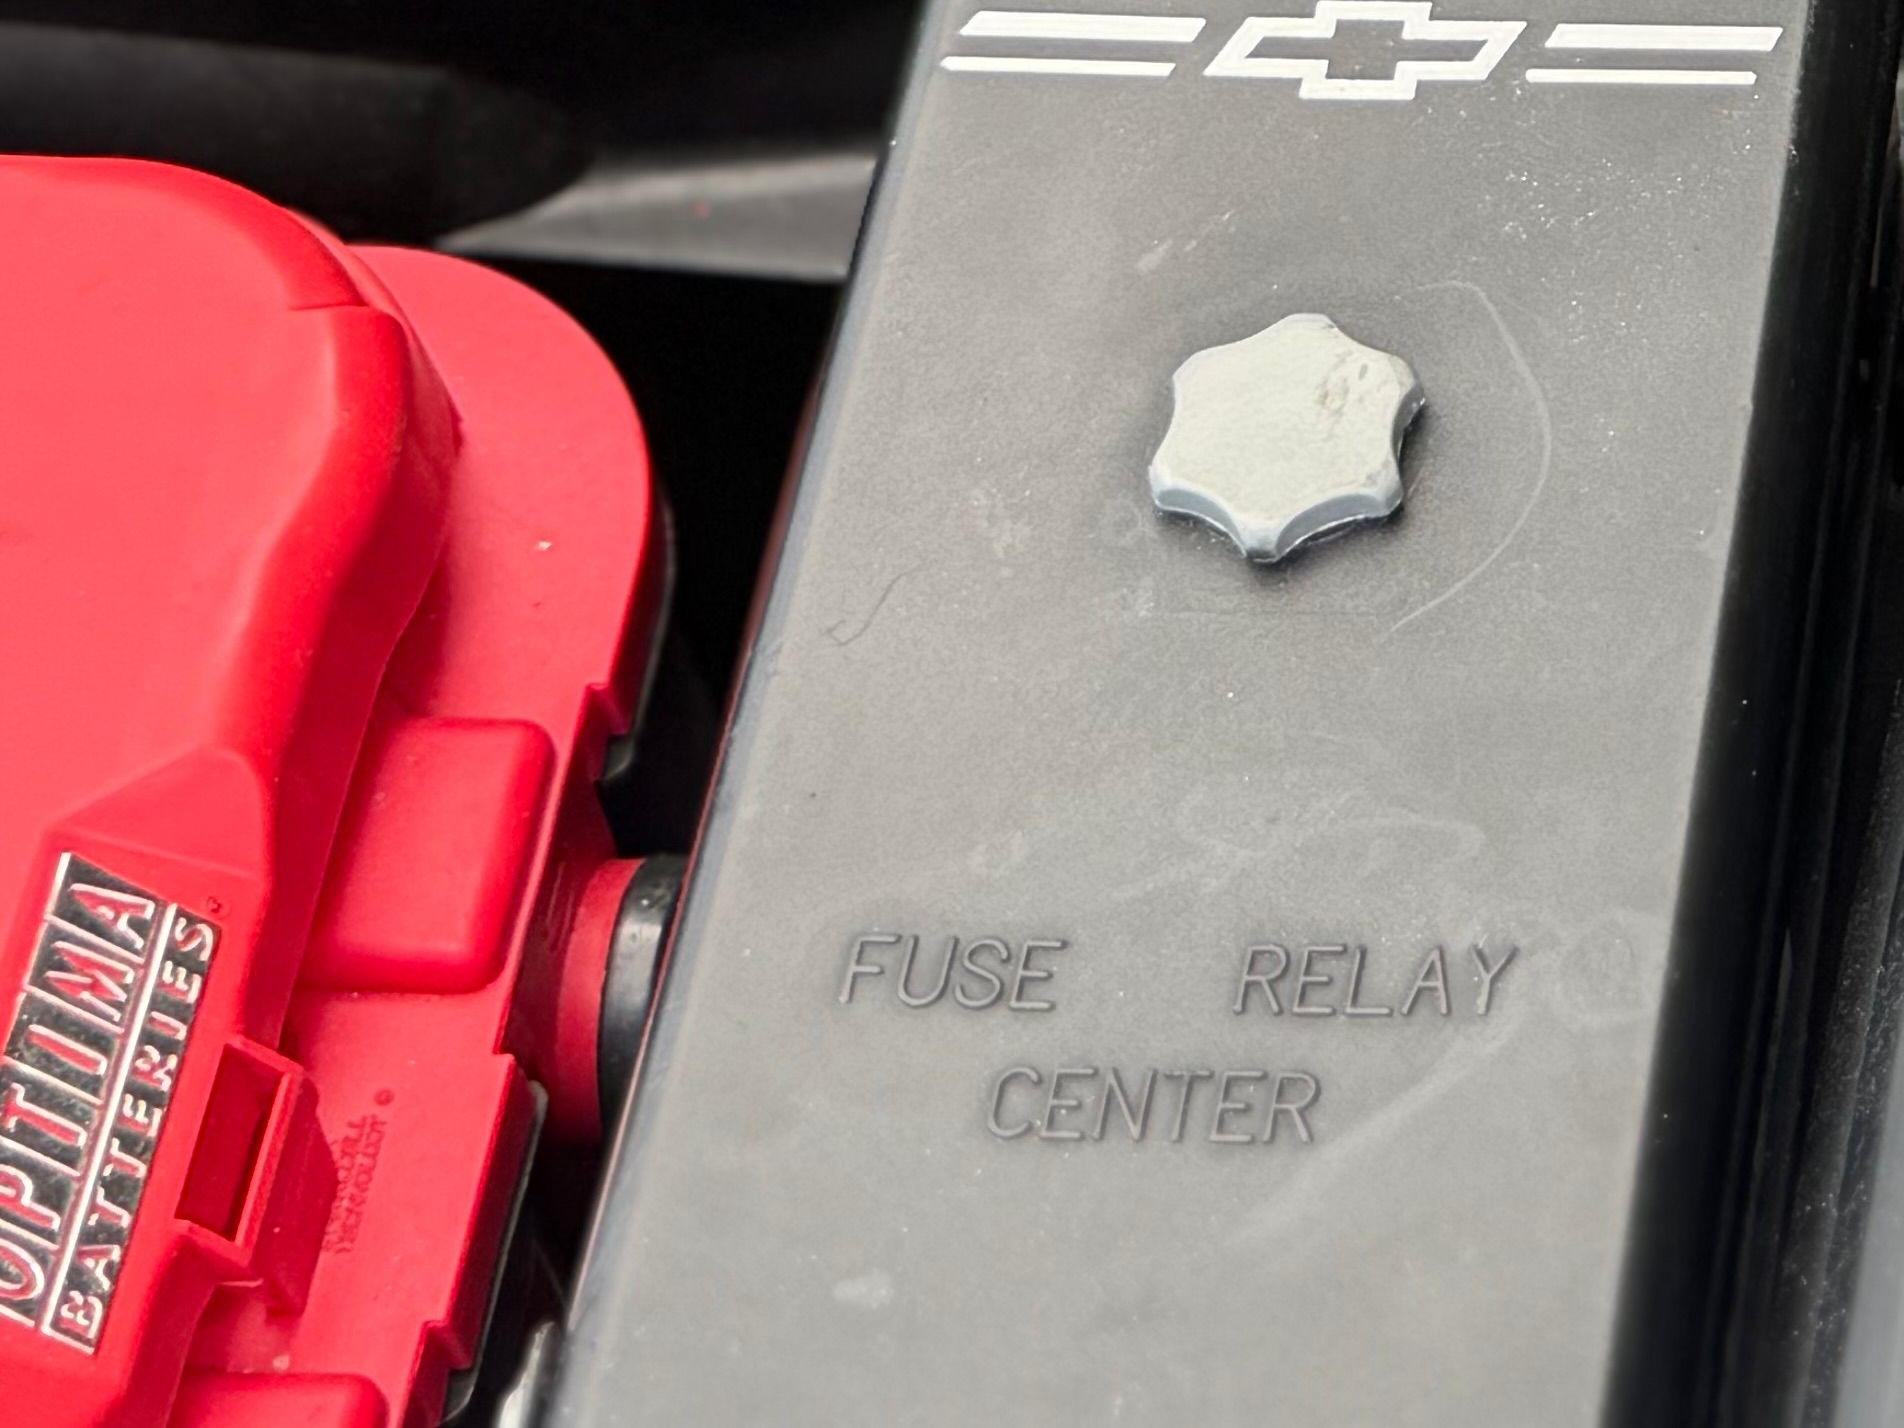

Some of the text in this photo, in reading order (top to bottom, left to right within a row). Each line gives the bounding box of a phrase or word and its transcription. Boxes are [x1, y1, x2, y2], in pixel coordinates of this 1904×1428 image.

[838, 933, 1519, 1016] FUSE RELAY
[60, 916, 214, 1338] BATTERIES
[986, 1065, 1321, 1144] CENTER
